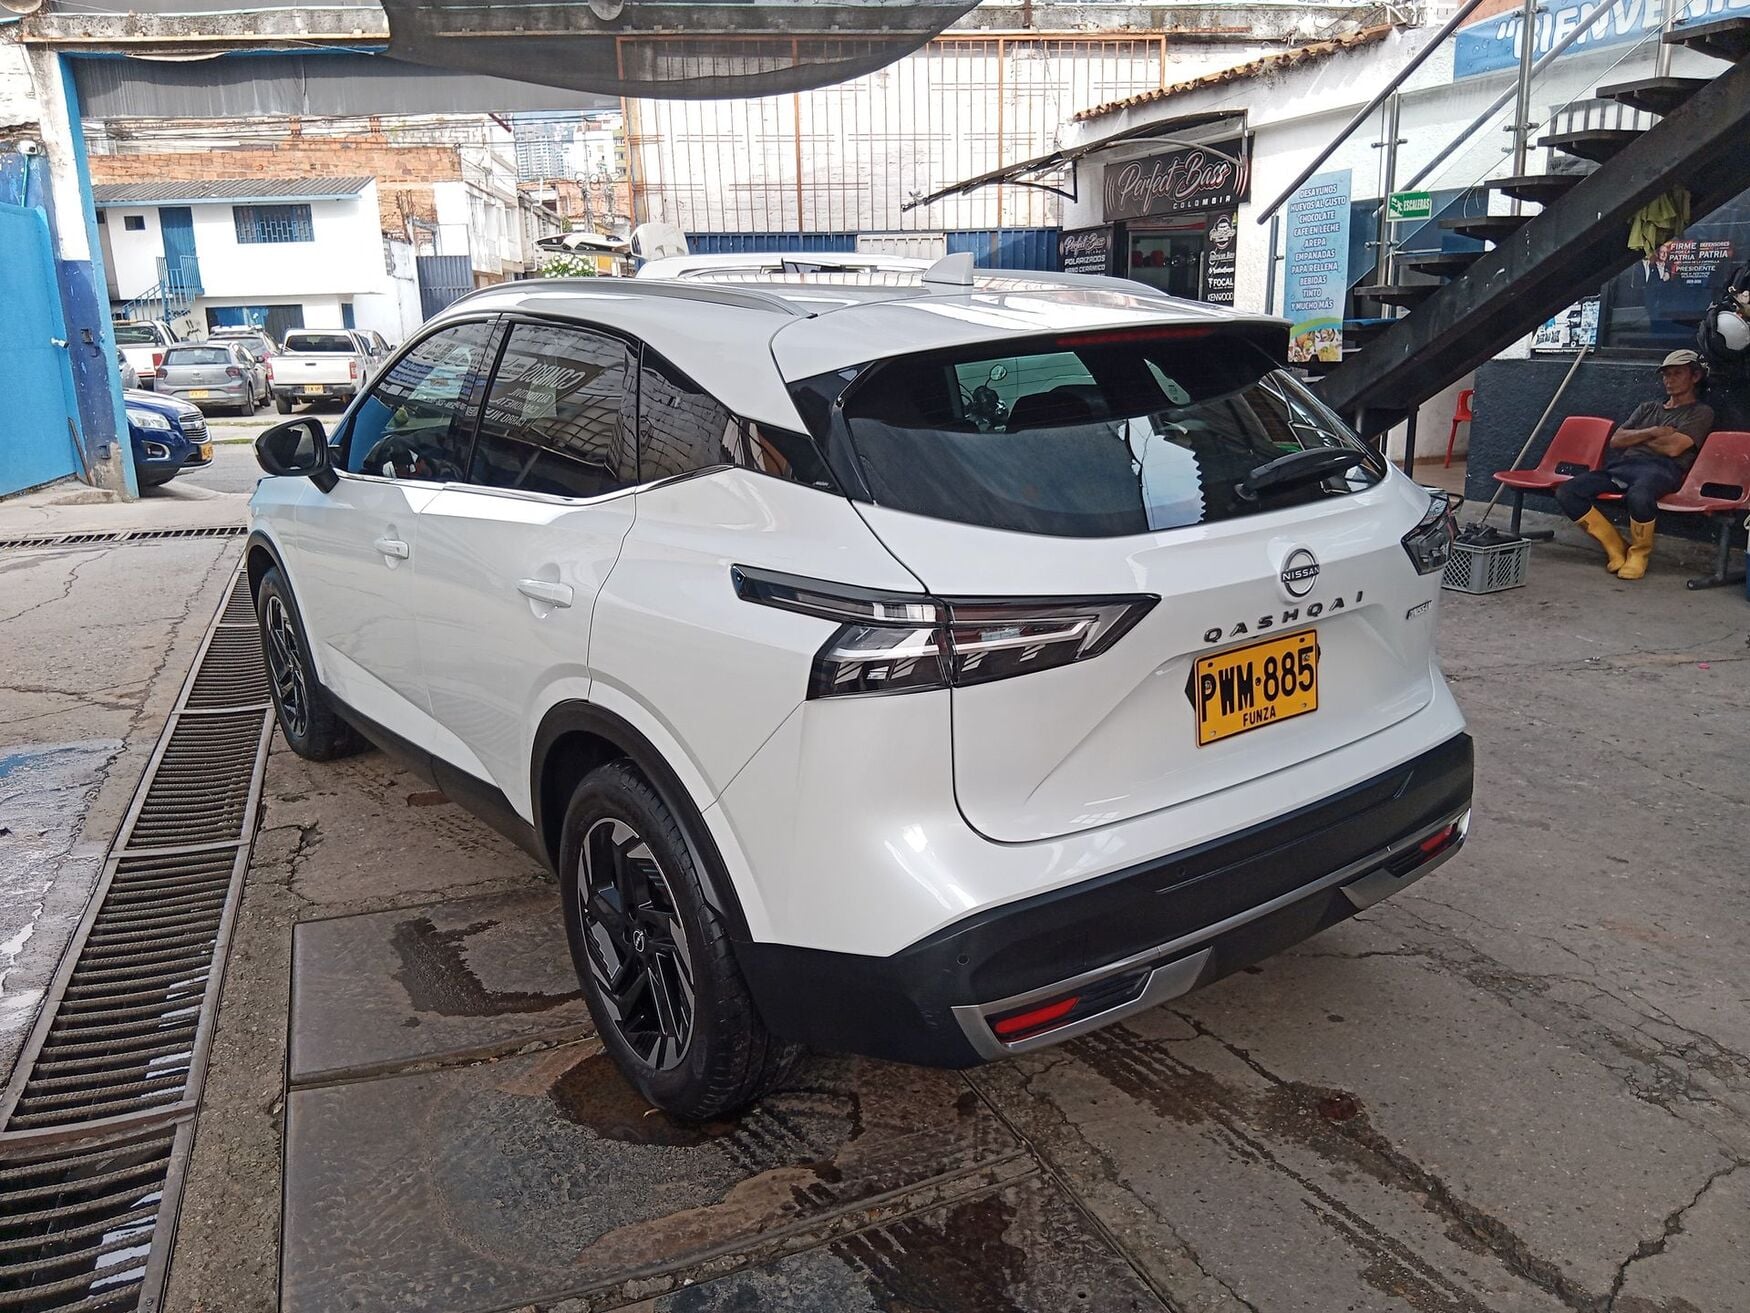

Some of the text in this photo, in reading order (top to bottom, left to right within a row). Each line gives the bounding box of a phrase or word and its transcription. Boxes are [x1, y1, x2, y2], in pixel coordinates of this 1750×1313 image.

[1118, 150, 1231, 213] Perfect Bass
[1300, 184, 1337, 198] DESAYUNOS
[1290, 196, 1346, 212] HUEVOS AL GUSTO
[1403, 199, 1430, 211] ESCALERAS
[1299, 210, 1335, 223] CHOCOLATE
[1293, 223, 1340, 237] CAFE EN LECHE
[1304, 238, 1326, 248] AREPA
[1670, 242, 1697, 250] FIRME
[1064, 254, 1106, 265] POLARIZADOS
[1295, 249, 1335, 261] EMPANADAS
[1698, 249, 1728, 258] PATRIA
[1291, 262, 1338, 274] PAPA RELLENA
[1213, 278, 1233, 287] FOCAL
[1299, 275, 1327, 286] BEBIDAS
[1207, 292, 1233, 301] KENWOOD
[1303, 288, 1321, 298] TINTO
[1291, 302, 1296, 310] Y
[1296, 301, 1318, 310] MUCHO
[1282, 566, 1319, 582] NISSAN
[1203, 591, 1364, 643] QASHQAI
[1243, 705, 1277, 727] FUNZA
